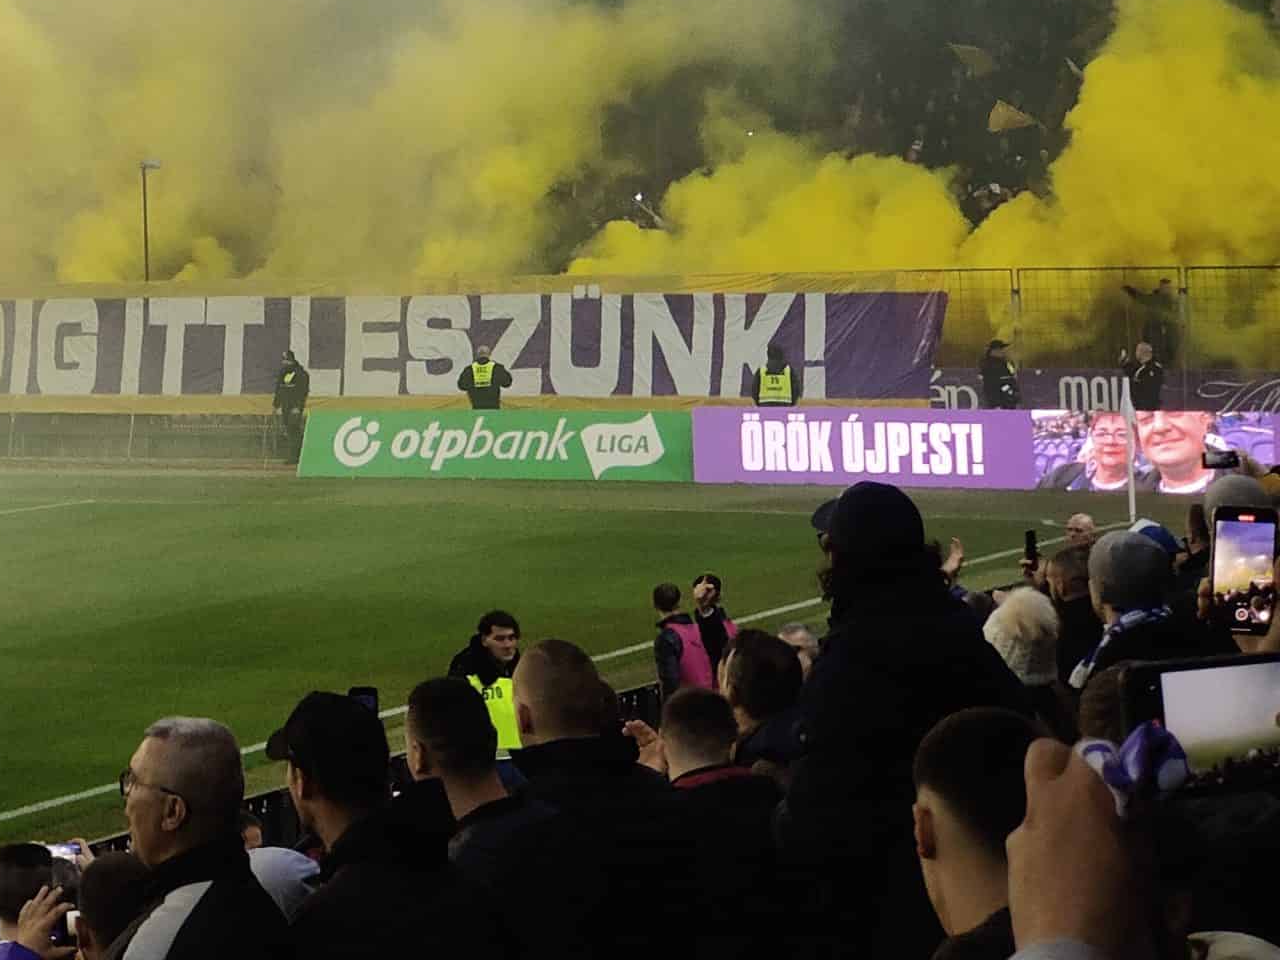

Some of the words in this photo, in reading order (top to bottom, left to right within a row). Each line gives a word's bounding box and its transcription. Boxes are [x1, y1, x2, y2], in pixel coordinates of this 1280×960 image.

[120, 297, 265, 397] ITT
[288, 284, 826, 399] LESZÜNK!
[391, 416, 576, 471] otpbank
[596, 434, 650, 454] LIGA
[741, 413, 835, 472] ÖRÖK
[841, 413, 985, 476] ÚJPEST!
